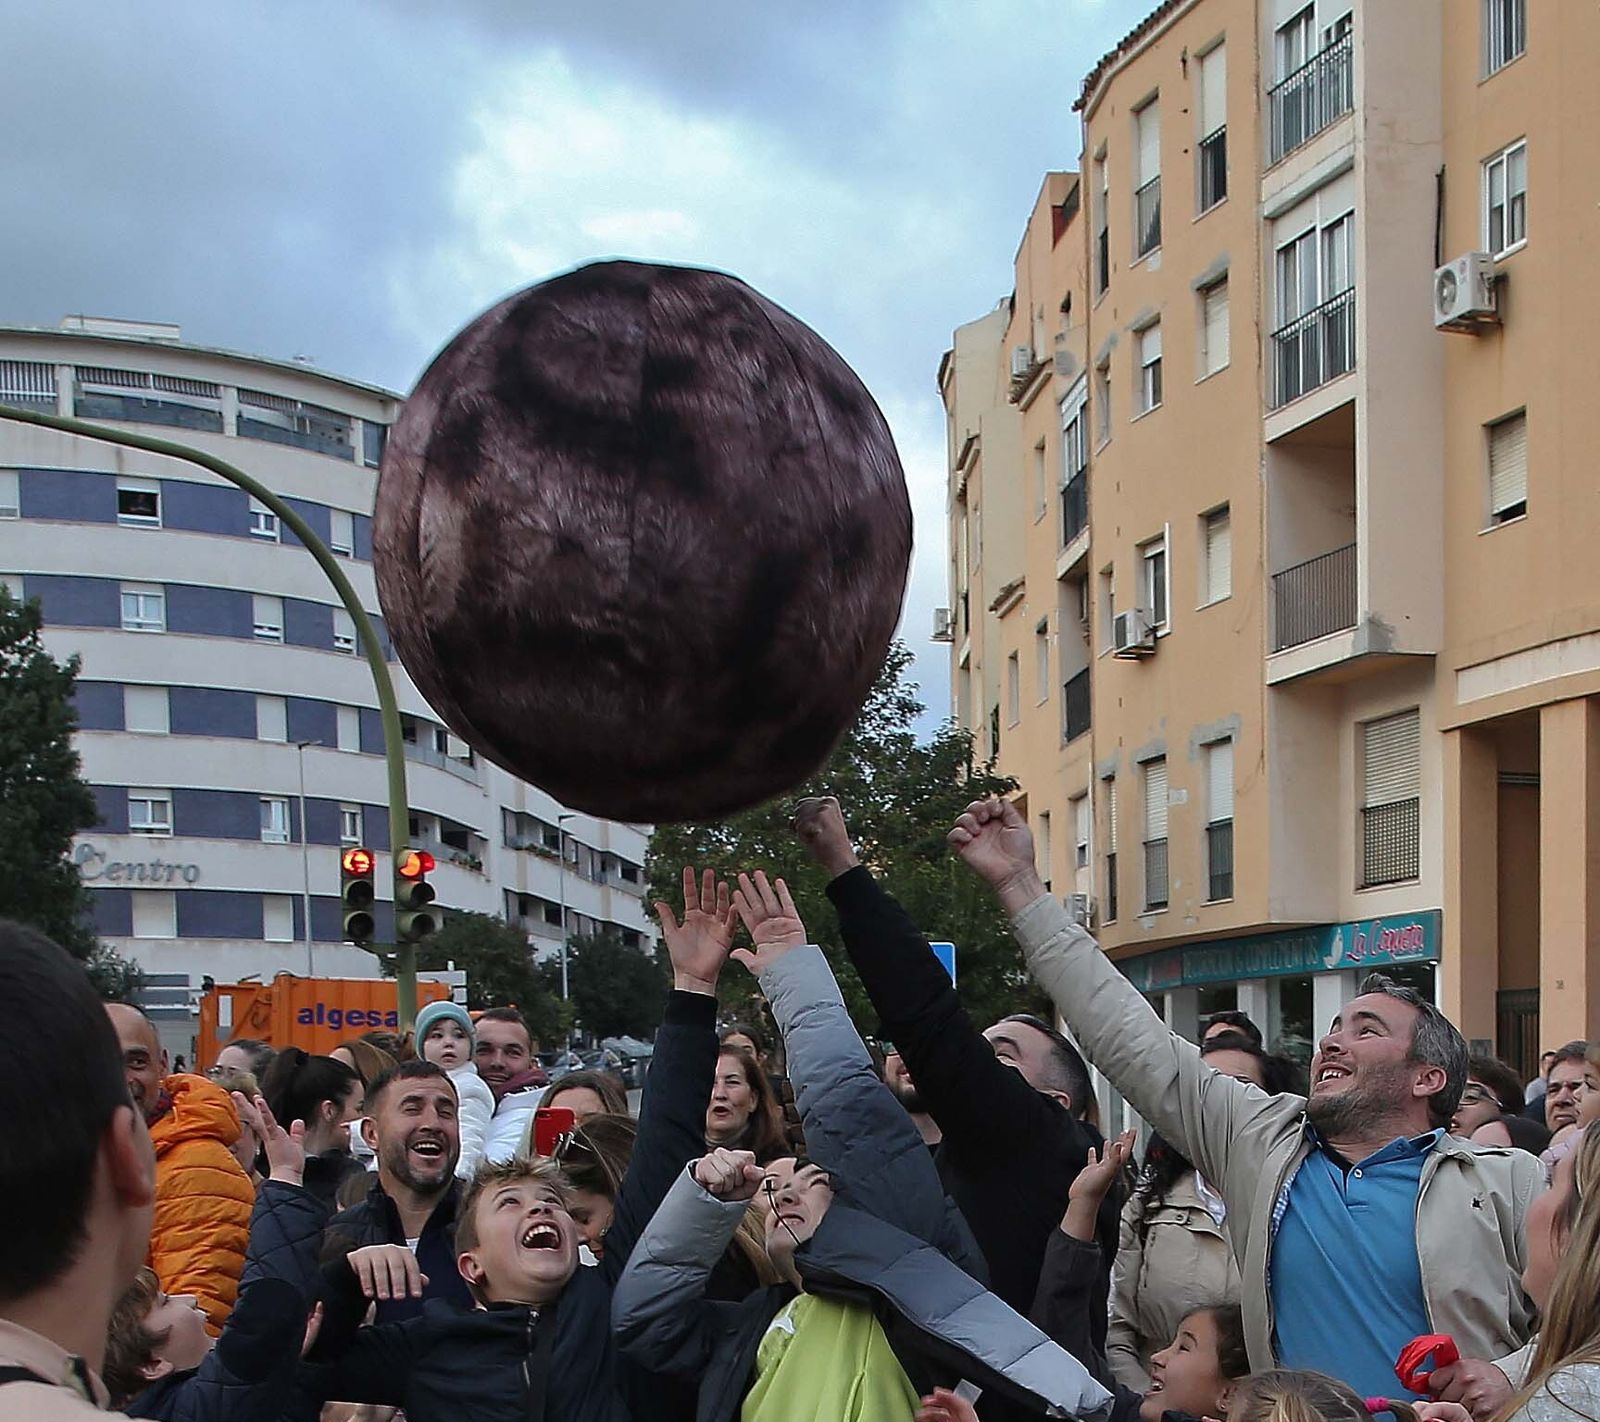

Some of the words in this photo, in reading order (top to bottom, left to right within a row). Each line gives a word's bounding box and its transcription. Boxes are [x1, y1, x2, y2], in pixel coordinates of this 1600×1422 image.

[75, 843, 200, 882] Centro
[1344, 922, 1366, 963] La
[297, 1003, 398, 1030] algesa
